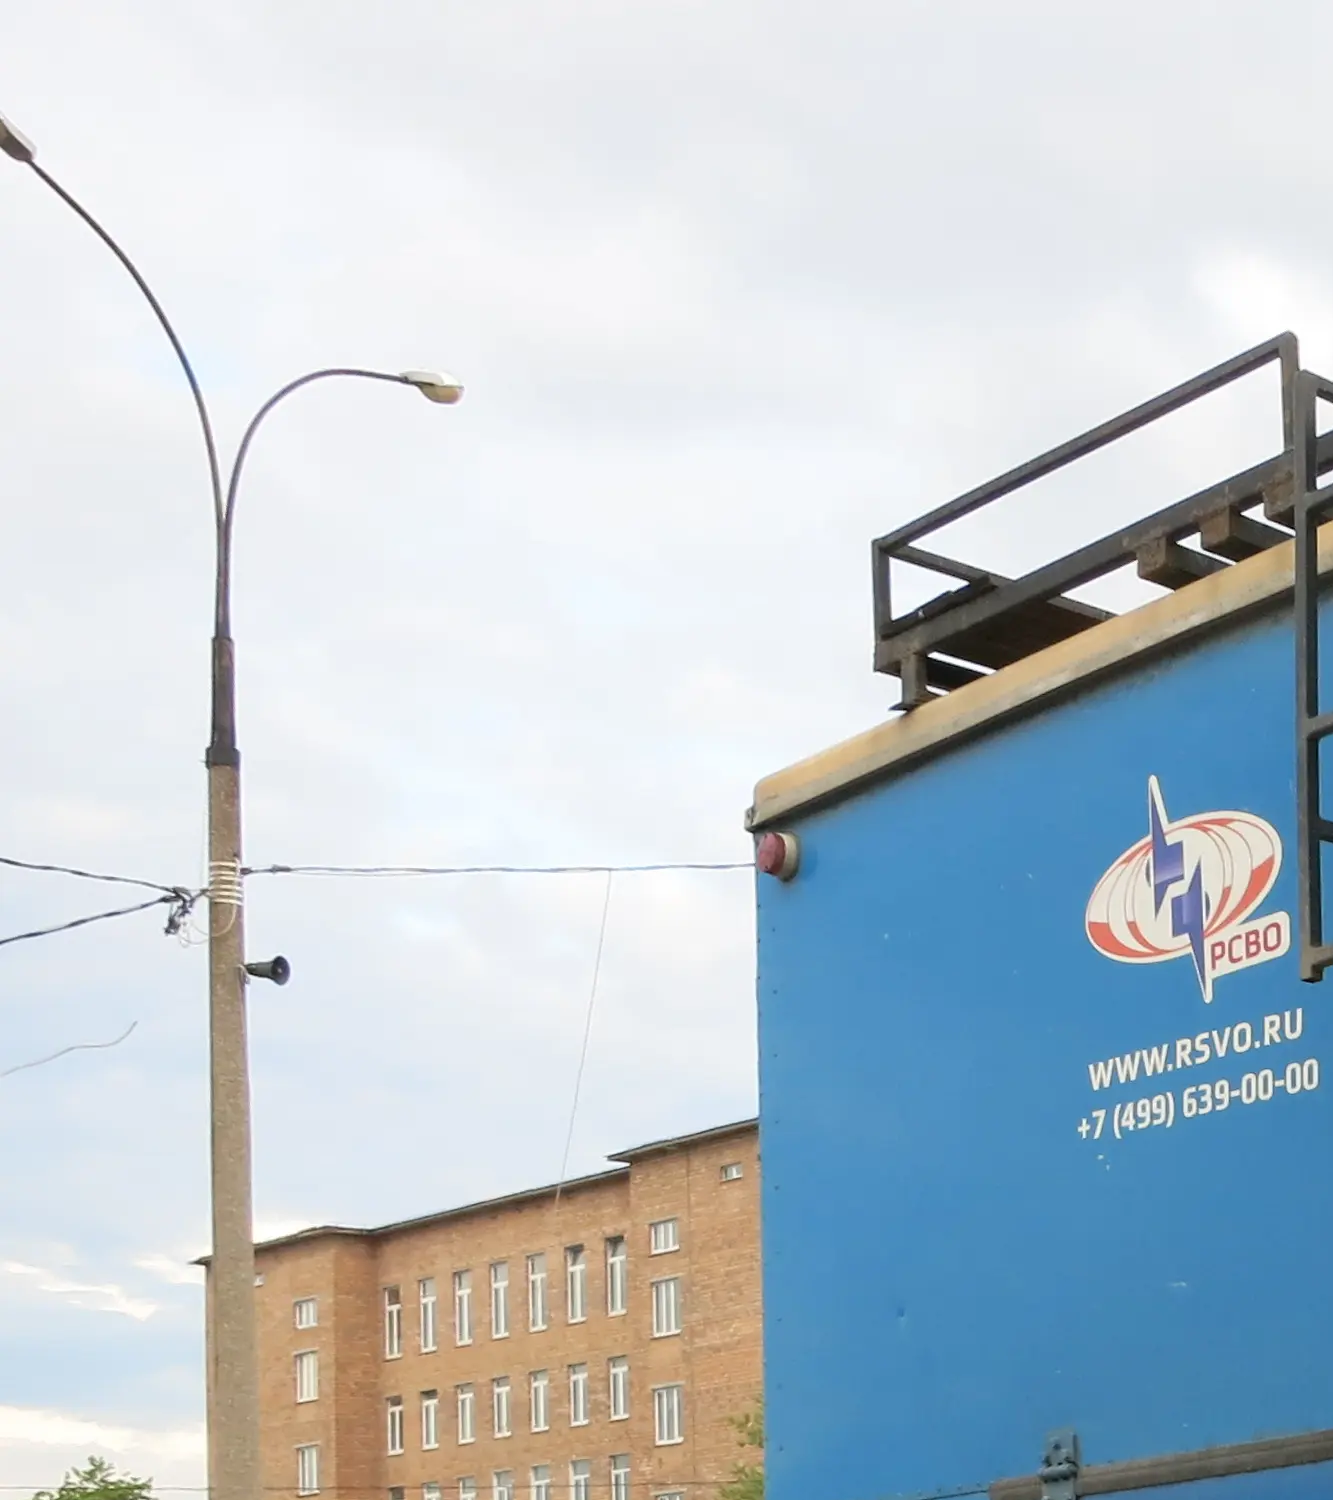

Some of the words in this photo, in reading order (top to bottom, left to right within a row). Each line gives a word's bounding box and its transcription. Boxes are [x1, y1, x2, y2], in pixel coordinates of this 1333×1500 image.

[1210, 921, 1283, 971] РСВО
[1088, 1007, 1304, 1092] WWW.RSVO.RU
[1077, 1109, 1107, 1140] +7
[1113, 1091, 1175, 1140] (499)
[1182, 1058, 1319, 1119] 639-00-00
